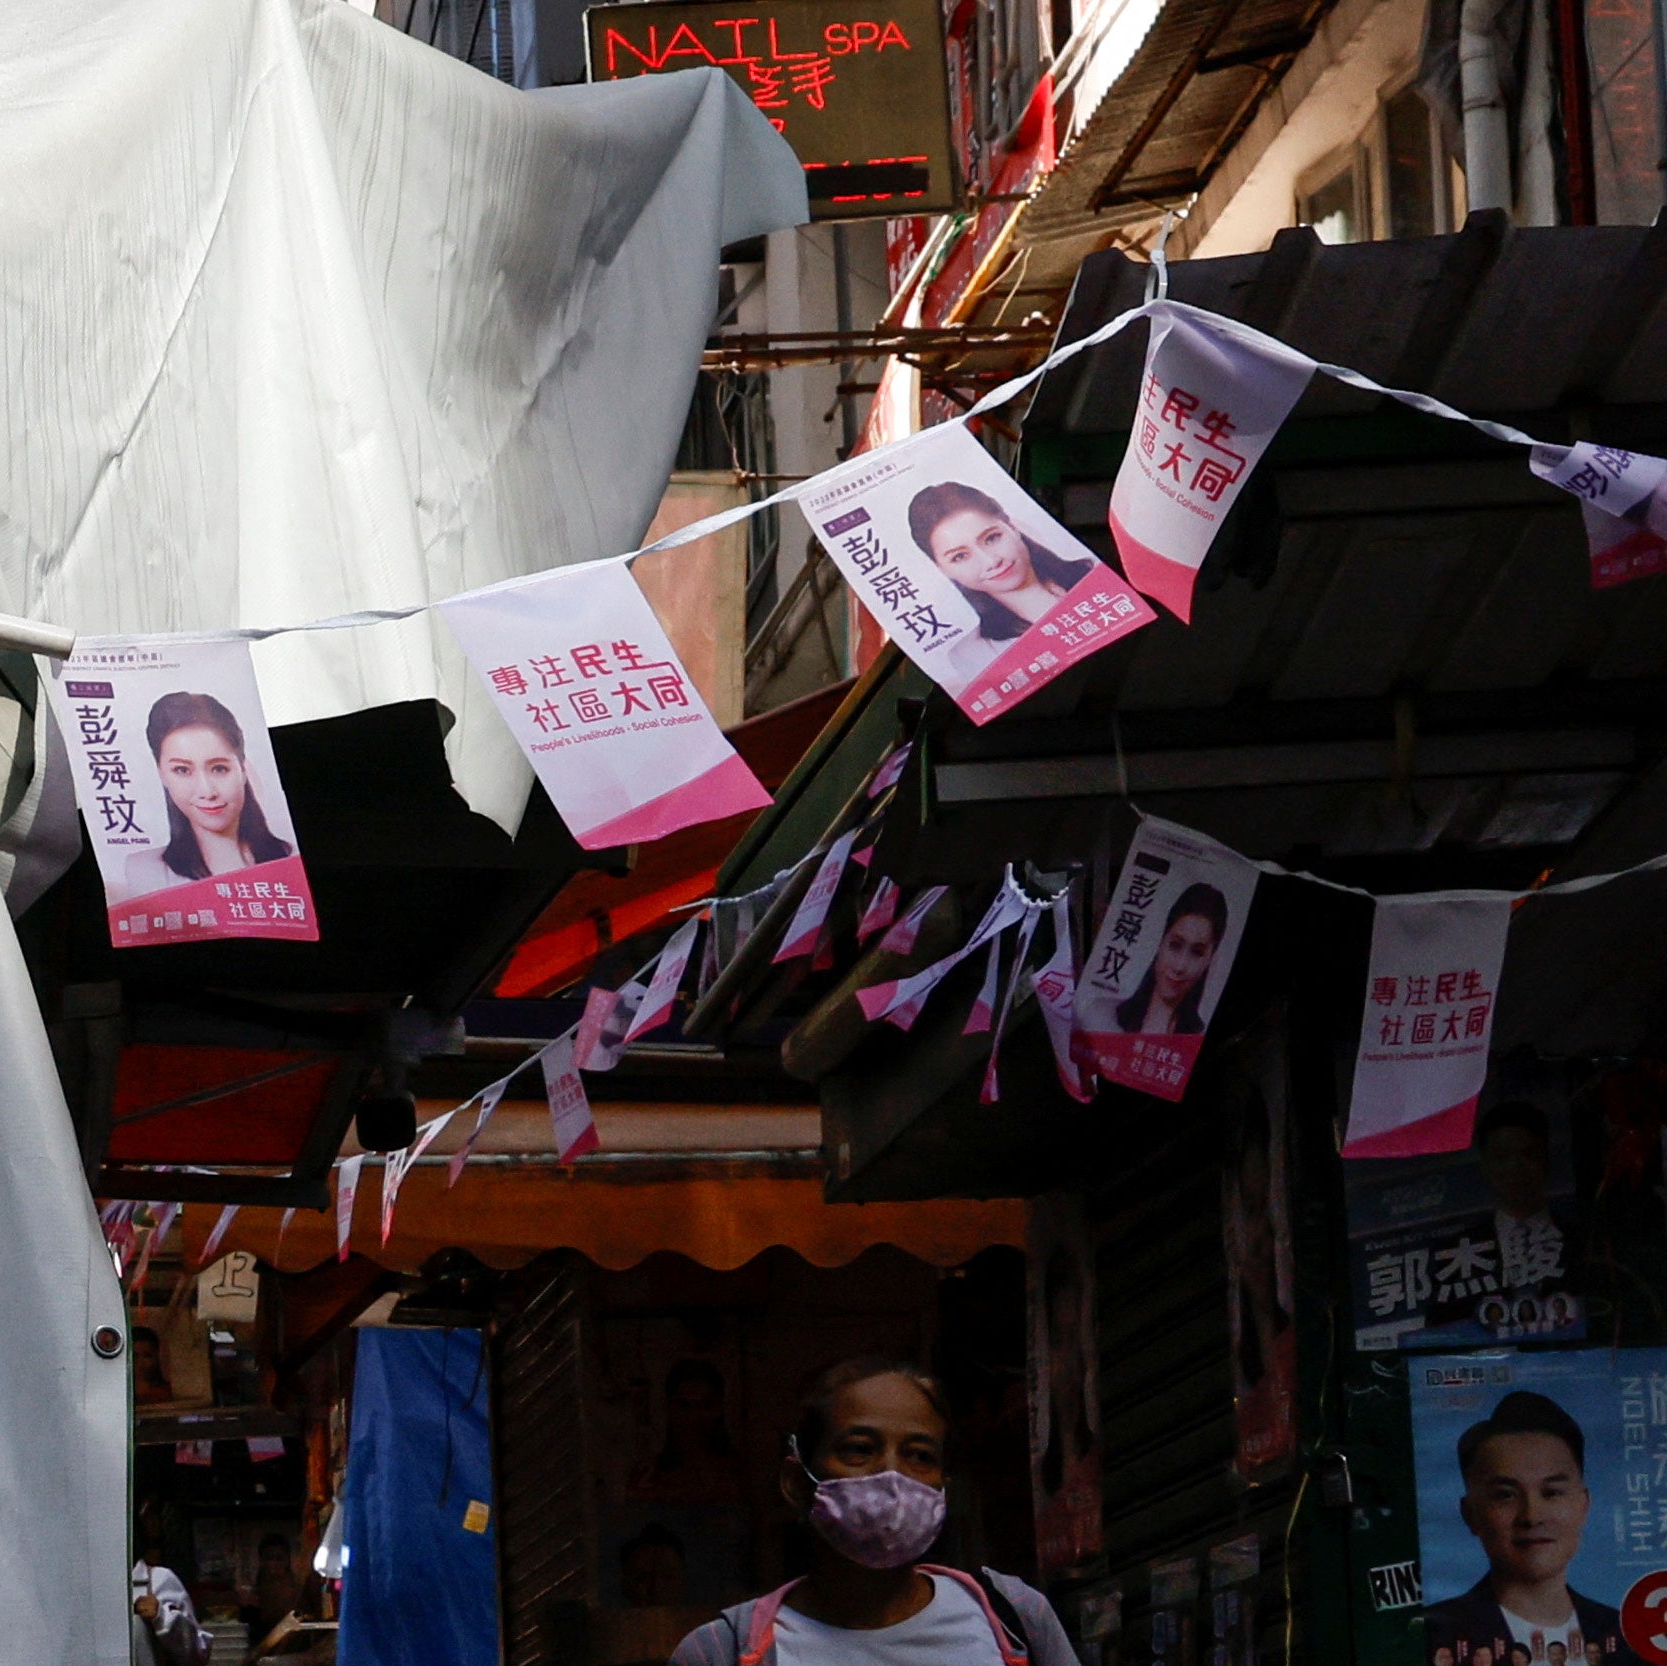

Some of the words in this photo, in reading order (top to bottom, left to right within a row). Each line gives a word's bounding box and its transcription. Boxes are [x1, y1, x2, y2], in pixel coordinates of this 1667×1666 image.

[607, 18, 819, 71] NAIL
[825, 21, 911, 55] SPA
[842, 527, 952, 643] 彭舜玟
[487, 638, 662, 697] 專注民生
[525, 674, 690, 733] 社區大同
[75, 704, 144, 834] 彭舜玟
[1096, 873, 1162, 984] 彭舜玟
[1370, 968, 1490, 1007] 專注民生
[1378, 1005, 1491, 1047] 社區大同
[1366, 1213, 1565, 1318] 郭杰駿
